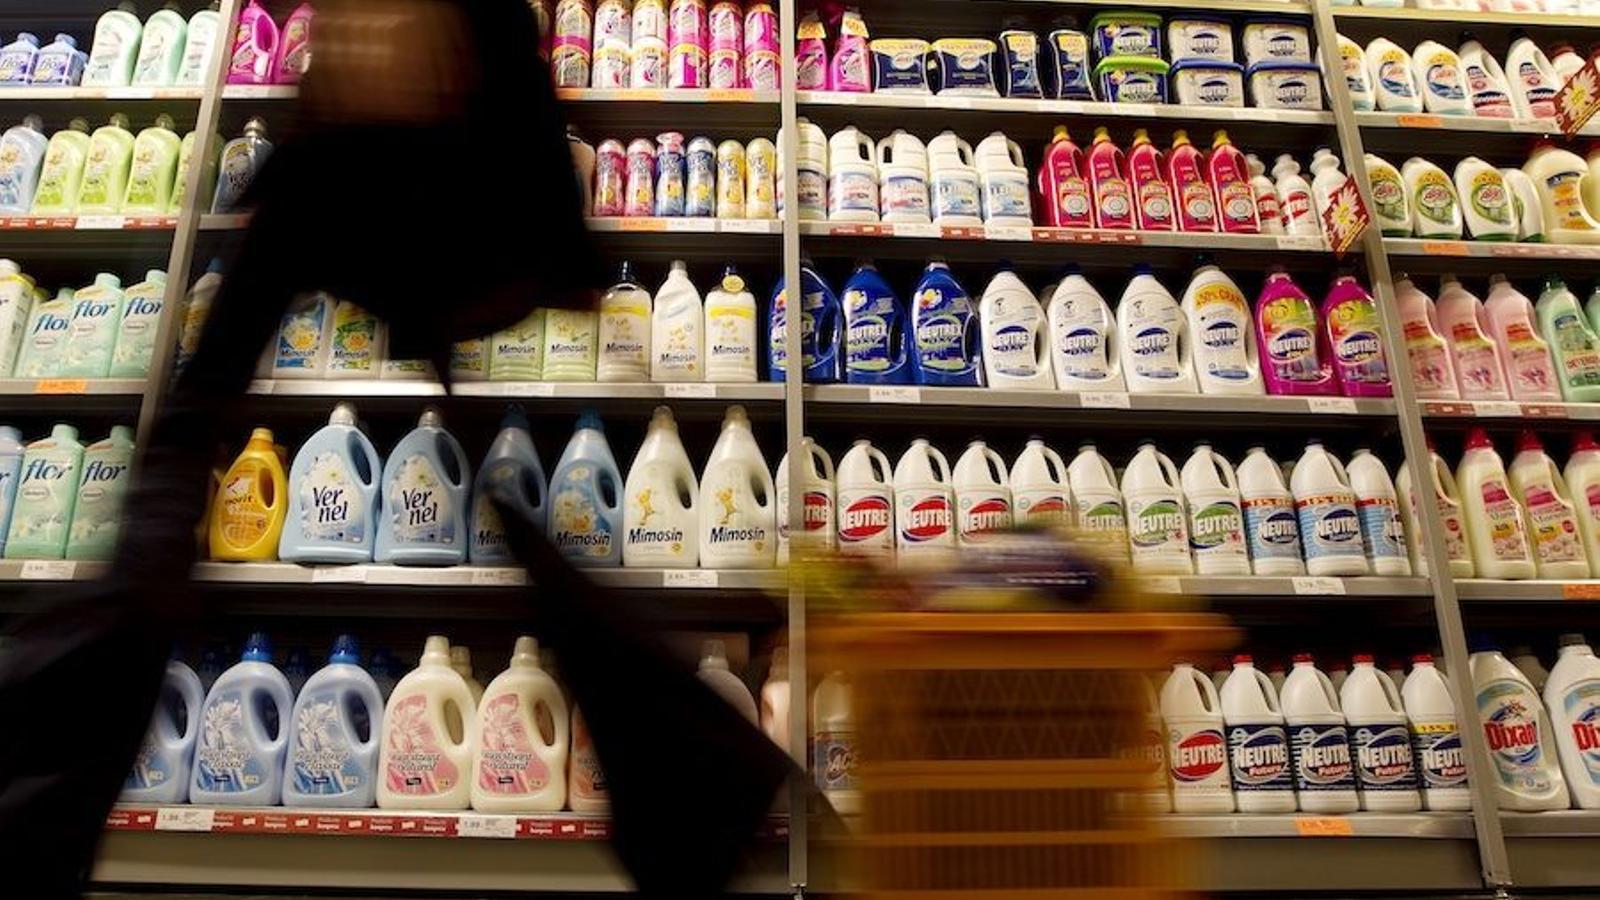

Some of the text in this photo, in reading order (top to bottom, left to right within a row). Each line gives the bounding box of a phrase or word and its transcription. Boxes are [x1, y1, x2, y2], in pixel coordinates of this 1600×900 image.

[73, 300, 116, 319] flor
[659, 352, 697, 364] Mimosin
[23, 459, 73, 485] flor
[82, 460, 127, 486] flor
[313, 486, 344, 507] Ver
[402, 488, 432, 511] Ver
[318, 501, 349, 523] nel
[409, 504, 438, 526] nel
[839, 508, 888, 530] NEUTRE
[901, 508, 952, 530] NEUTRE
[961, 511, 1011, 532] NEUTRE
[627, 526, 684, 544] Mimosin
[709, 526, 765, 544] Mimosin
[1133, 513, 1182, 535] NEUTRE
[1189, 514, 1239, 536] NEUTRE
[1260, 519, 1297, 537] NEUTRE
[1316, 516, 1359, 537] NEUTRE
[555, 529, 611, 546] Mimosin
[1484, 721, 1538, 751] Dixan
[1572, 722, 1600, 751] Dix
[1171, 744, 1224, 768] NEUTRE
[1236, 744, 1287, 767] NEUTRE
[1303, 744, 1350, 768] NEUTR
[1359, 743, 1411, 768] NEUTRE
